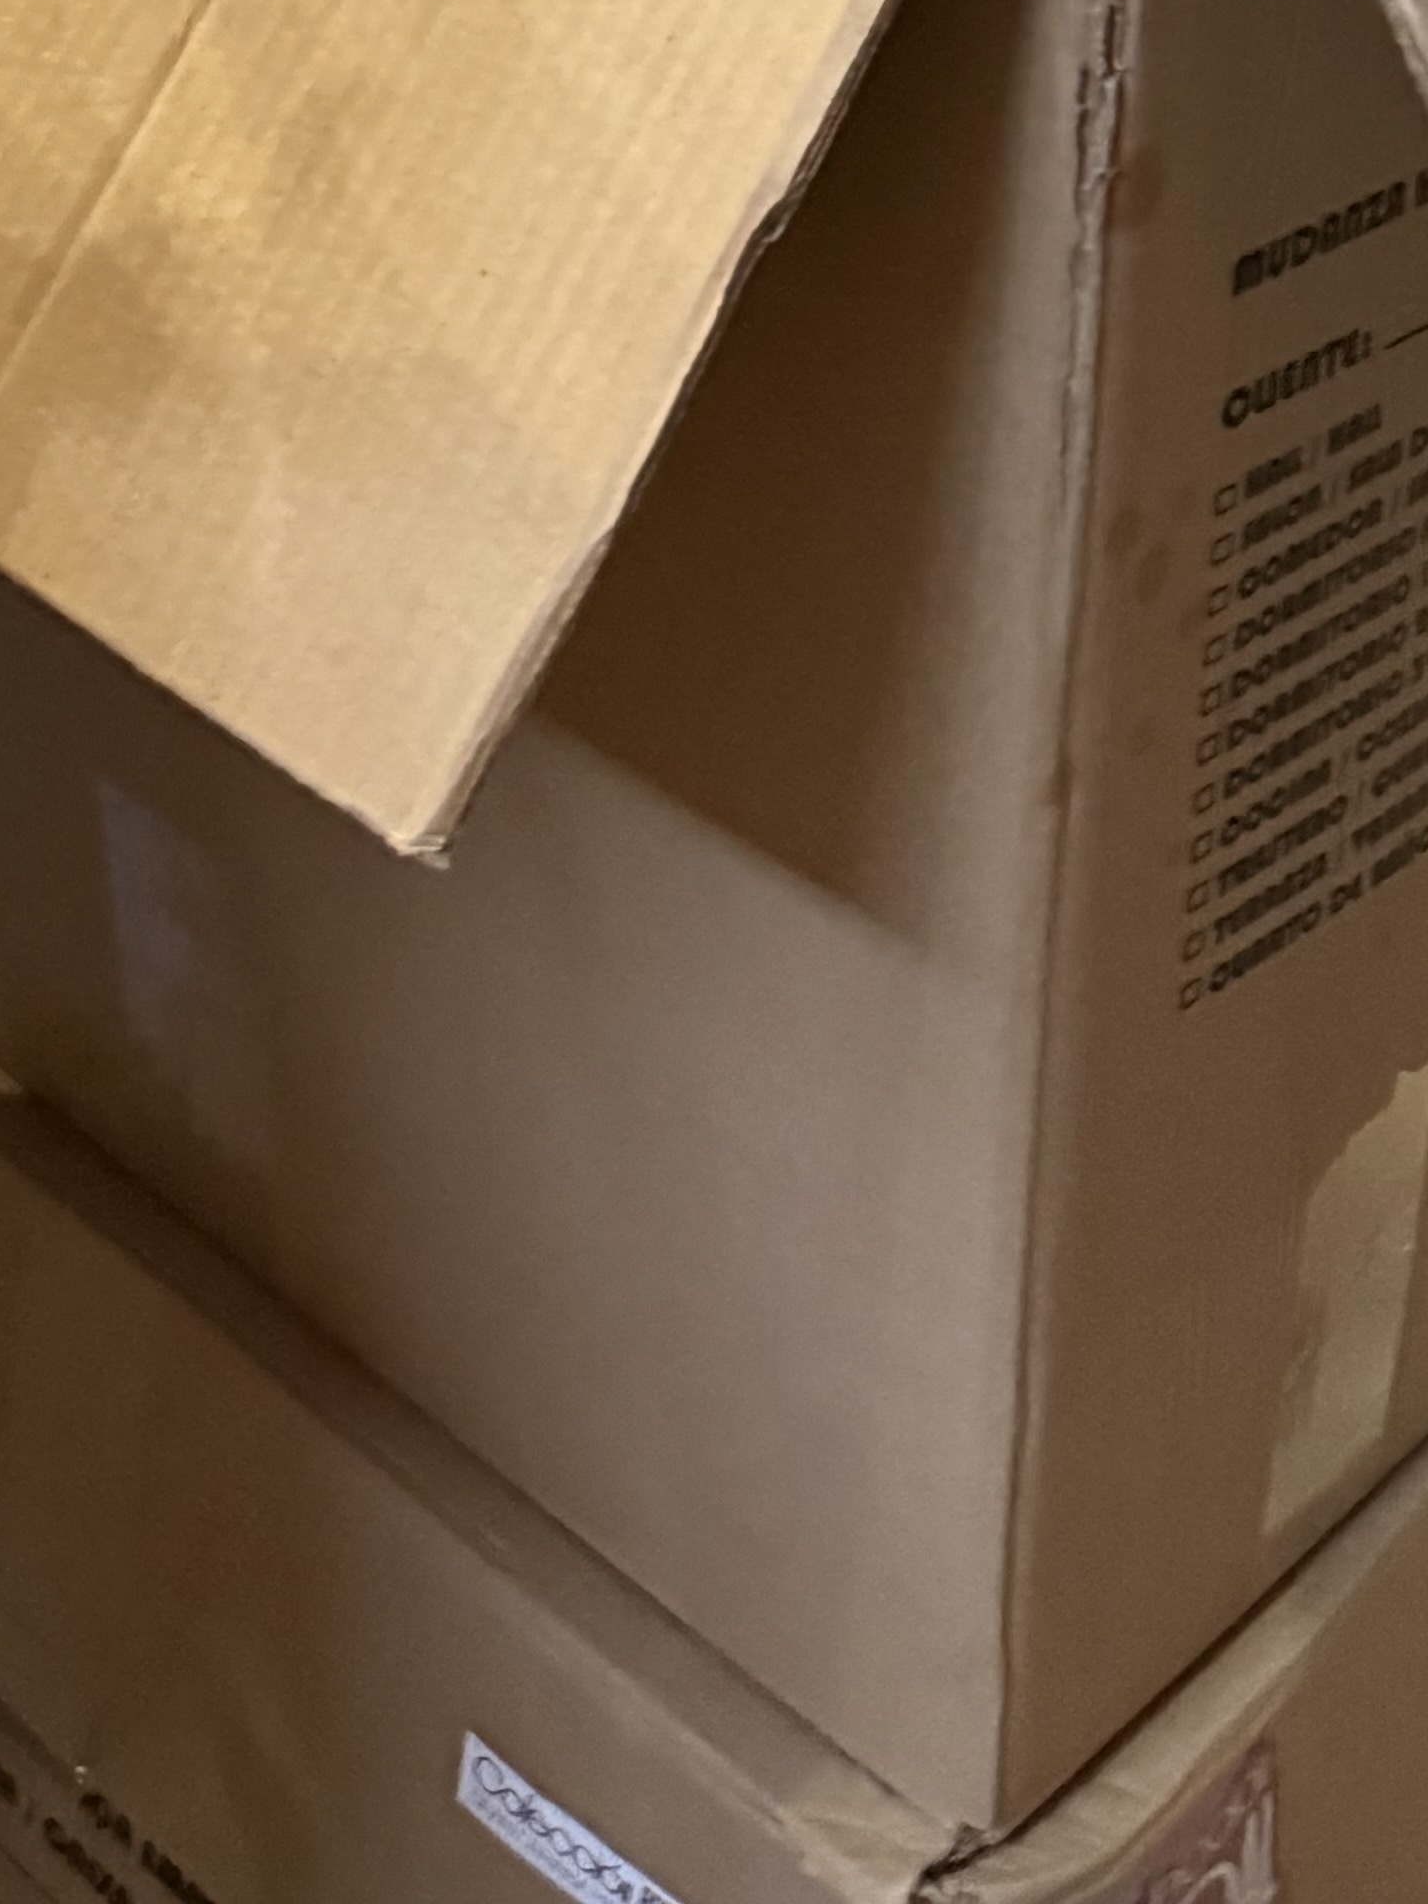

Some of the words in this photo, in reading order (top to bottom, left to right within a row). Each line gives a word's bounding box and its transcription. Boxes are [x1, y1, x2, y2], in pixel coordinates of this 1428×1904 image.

[1232, 182, 1406, 296] MUDANZA
[1234, 526, 1417, 649] DORMITORIO
[1238, 498, 1382, 599] COMEDOR
[1226, 623, 1408, 749] DORMITORIO
[1231, 573, 1409, 698] DORMITORIO
[1223, 670, 1403, 799] DORMITORIO
